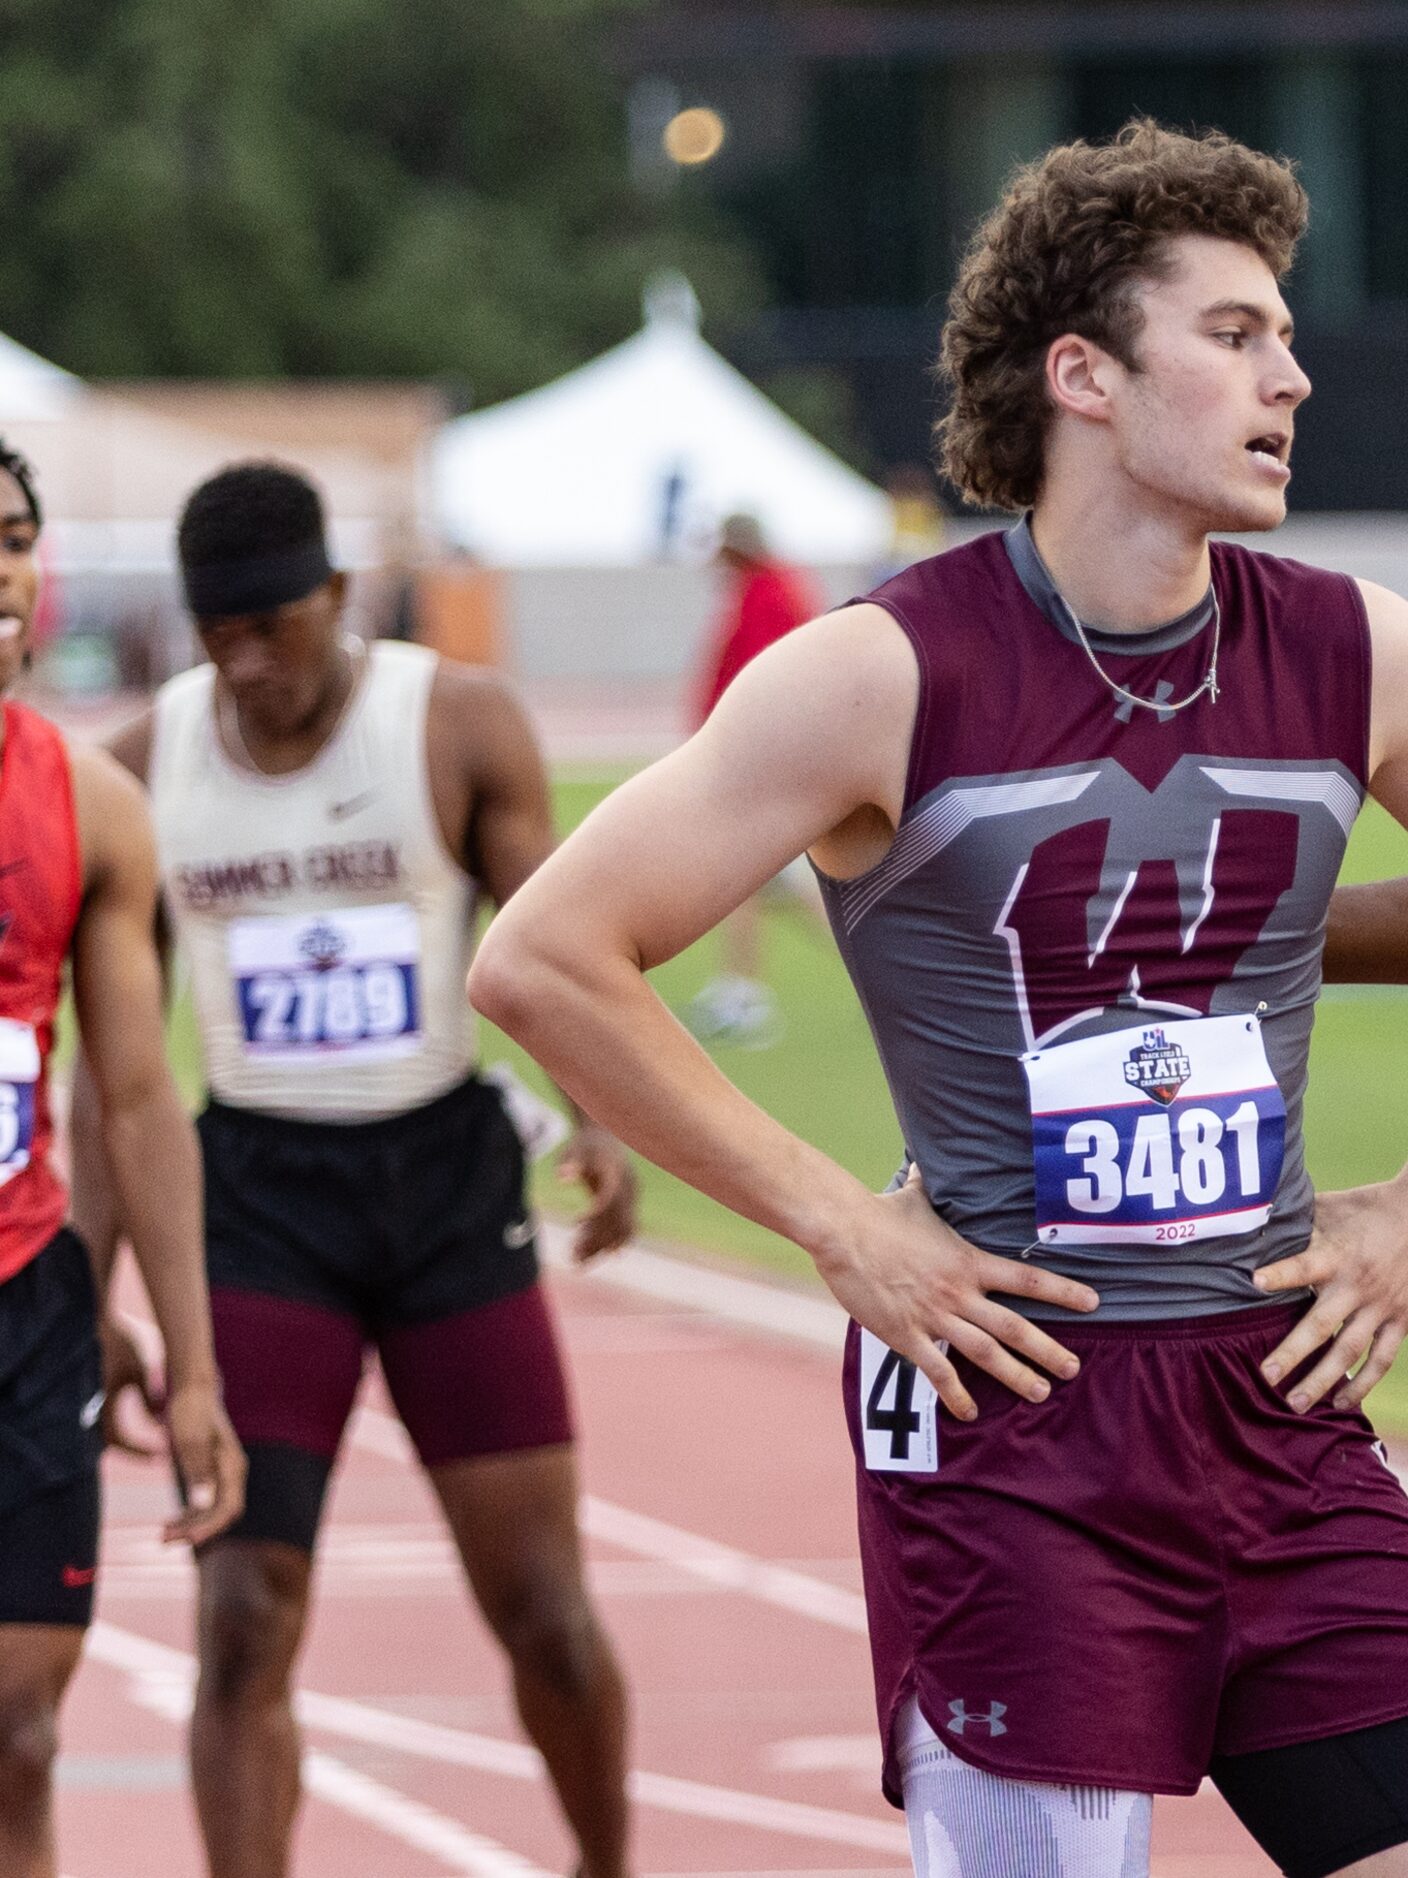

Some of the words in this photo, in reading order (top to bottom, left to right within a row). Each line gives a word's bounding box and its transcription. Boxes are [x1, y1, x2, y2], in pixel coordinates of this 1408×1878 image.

[993, 809, 1299, 1051] W
[1125, 1057, 1191, 1081] STATE
[1064, 1101, 1261, 1214] 3481
[1156, 1223, 1196, 1241] 2022
[867, 1347, 920, 1460] 4
